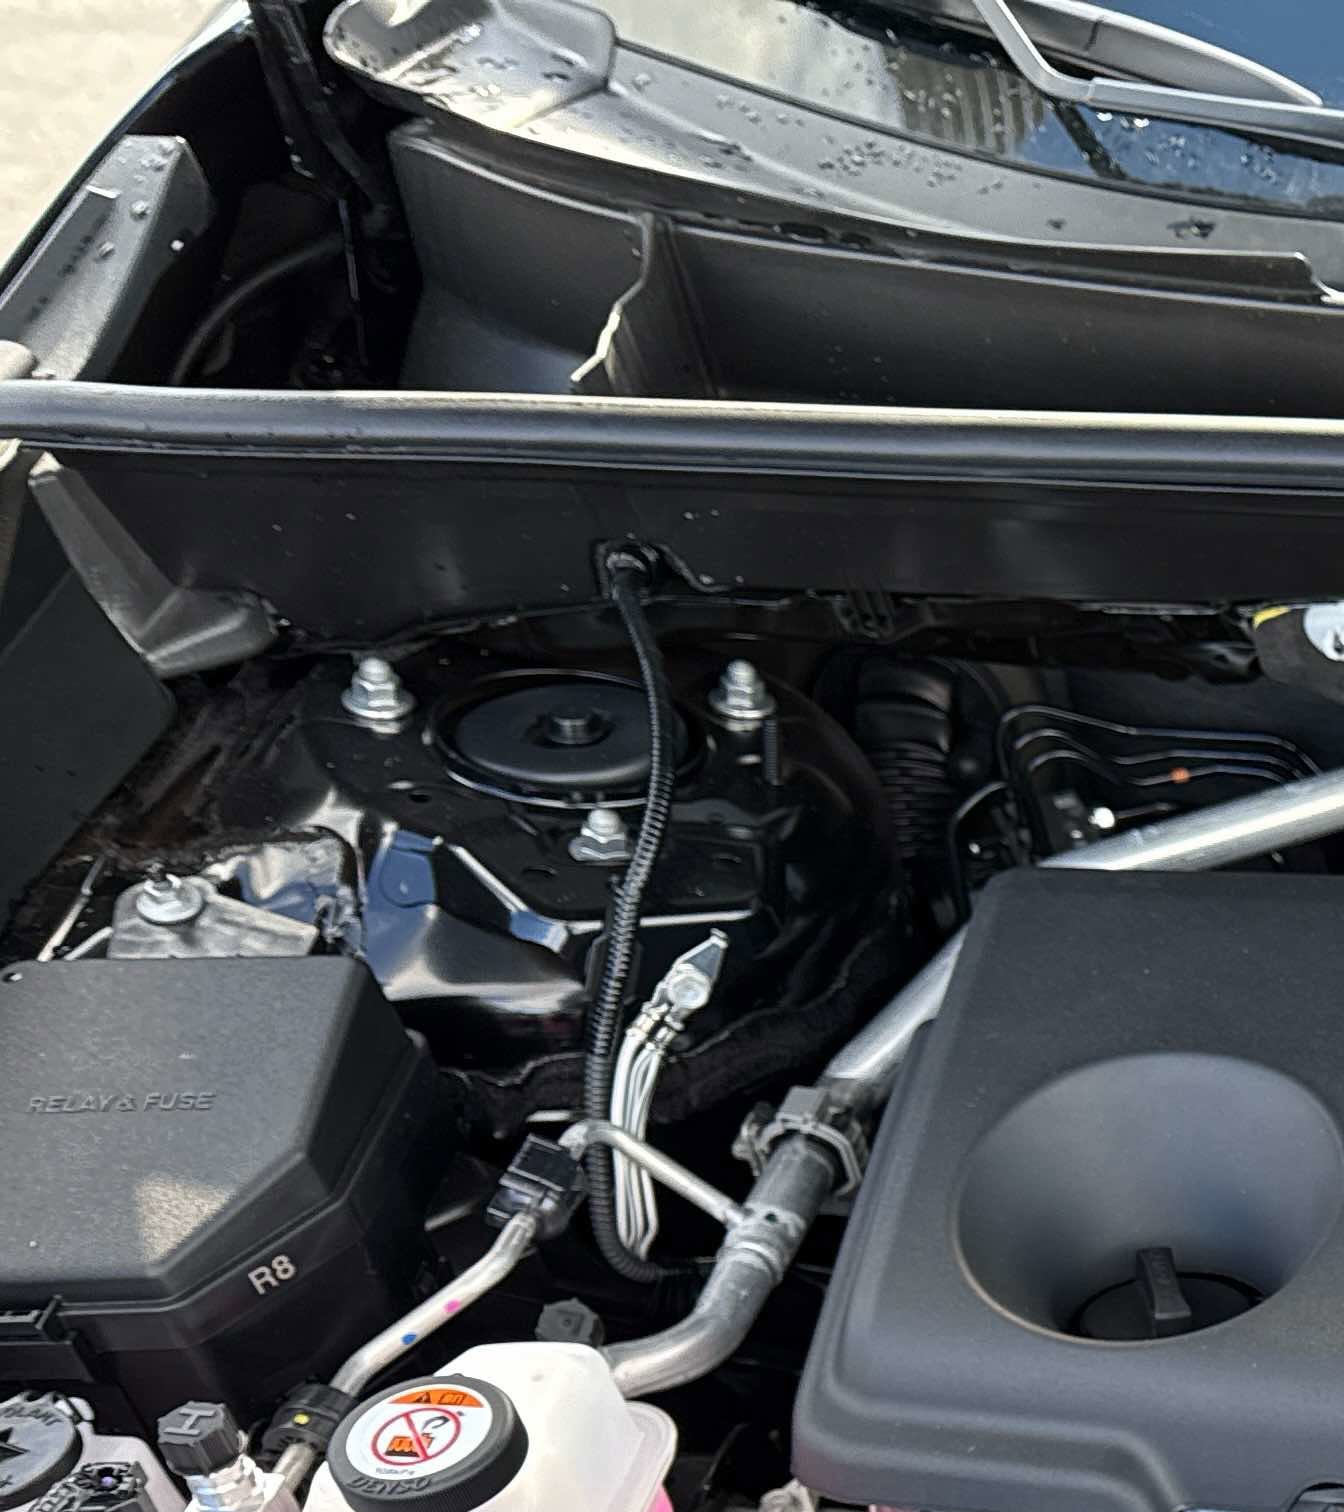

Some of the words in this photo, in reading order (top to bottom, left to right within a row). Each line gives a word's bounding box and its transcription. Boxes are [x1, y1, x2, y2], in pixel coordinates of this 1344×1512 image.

[26, 1094, 113, 1113] RELAY
[143, 1091, 217, 1112] FUSE
[247, 1254, 297, 1296] R8
[348, 1476, 434, 1497] DENSO
